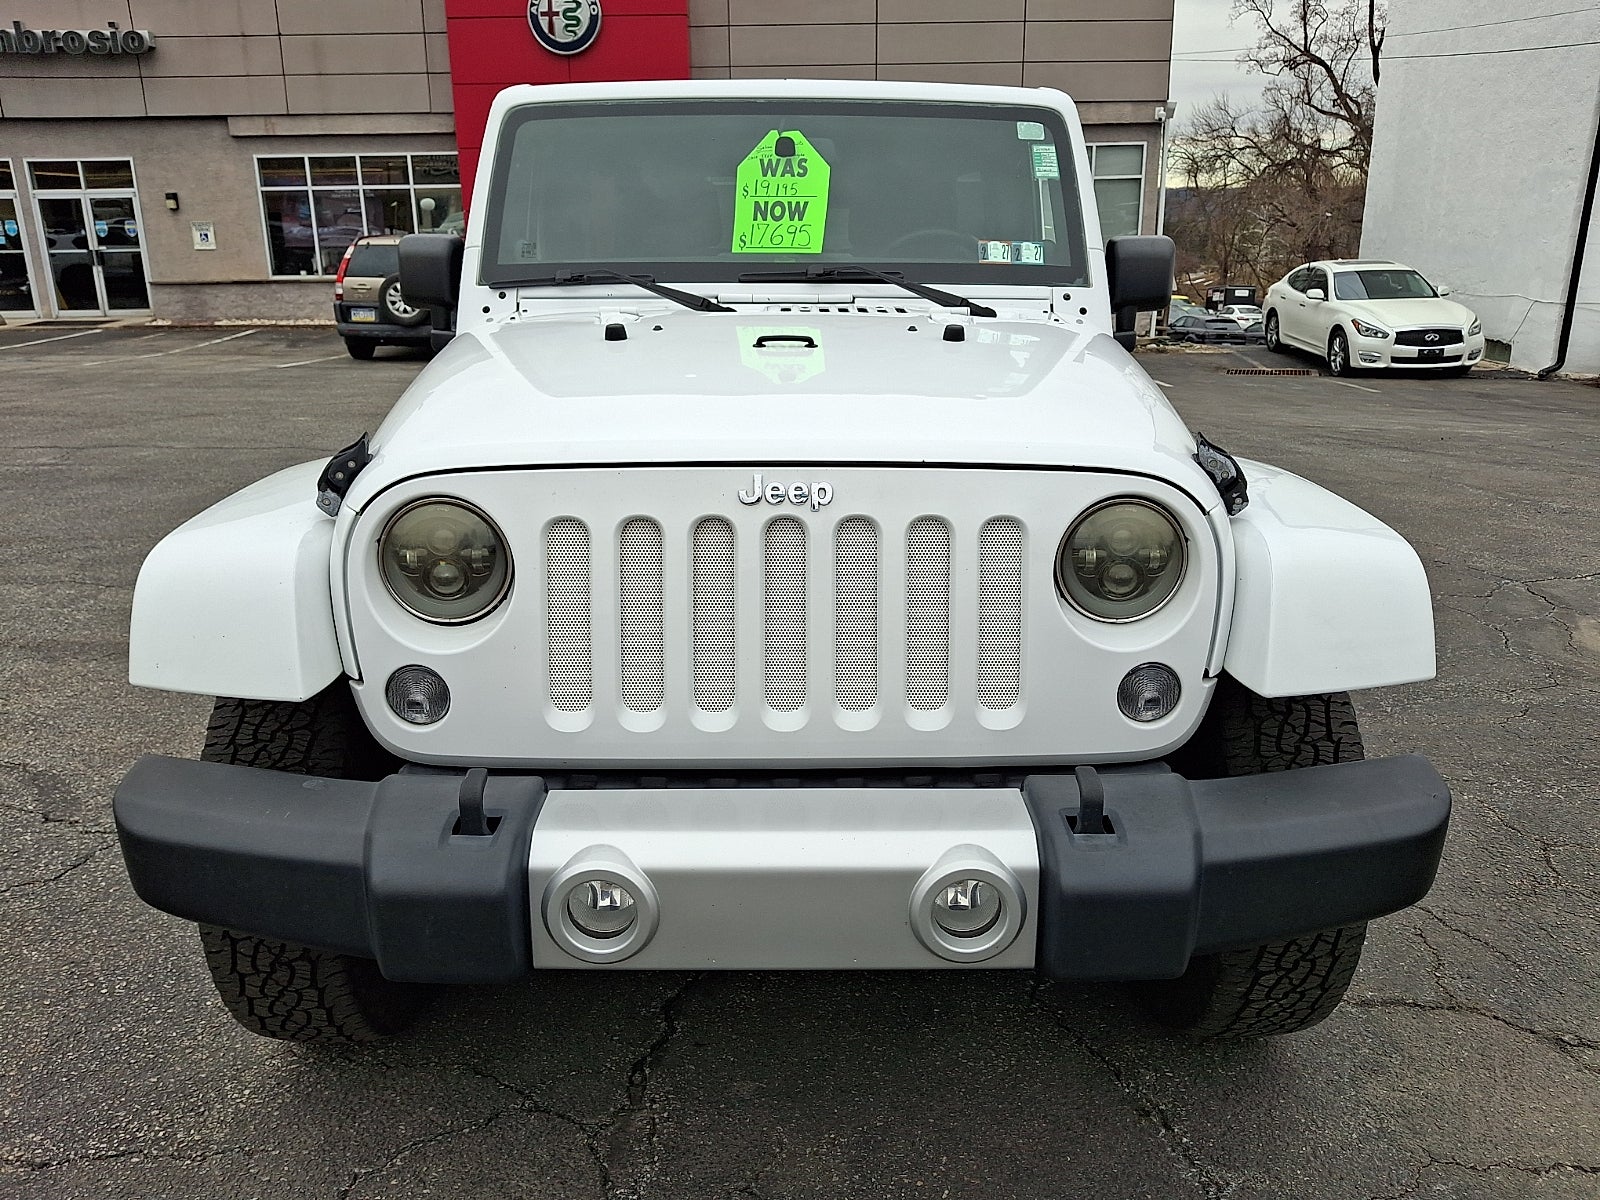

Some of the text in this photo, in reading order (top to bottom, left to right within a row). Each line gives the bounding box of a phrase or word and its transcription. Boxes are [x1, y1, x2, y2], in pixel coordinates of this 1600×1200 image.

[759, 158, 809, 178] WAS
[752, 200, 809, 222] NOW
[1001, 244, 1010, 260] 27
[1033, 245, 1042, 262] 27
[738, 472, 834, 512] Jeep
